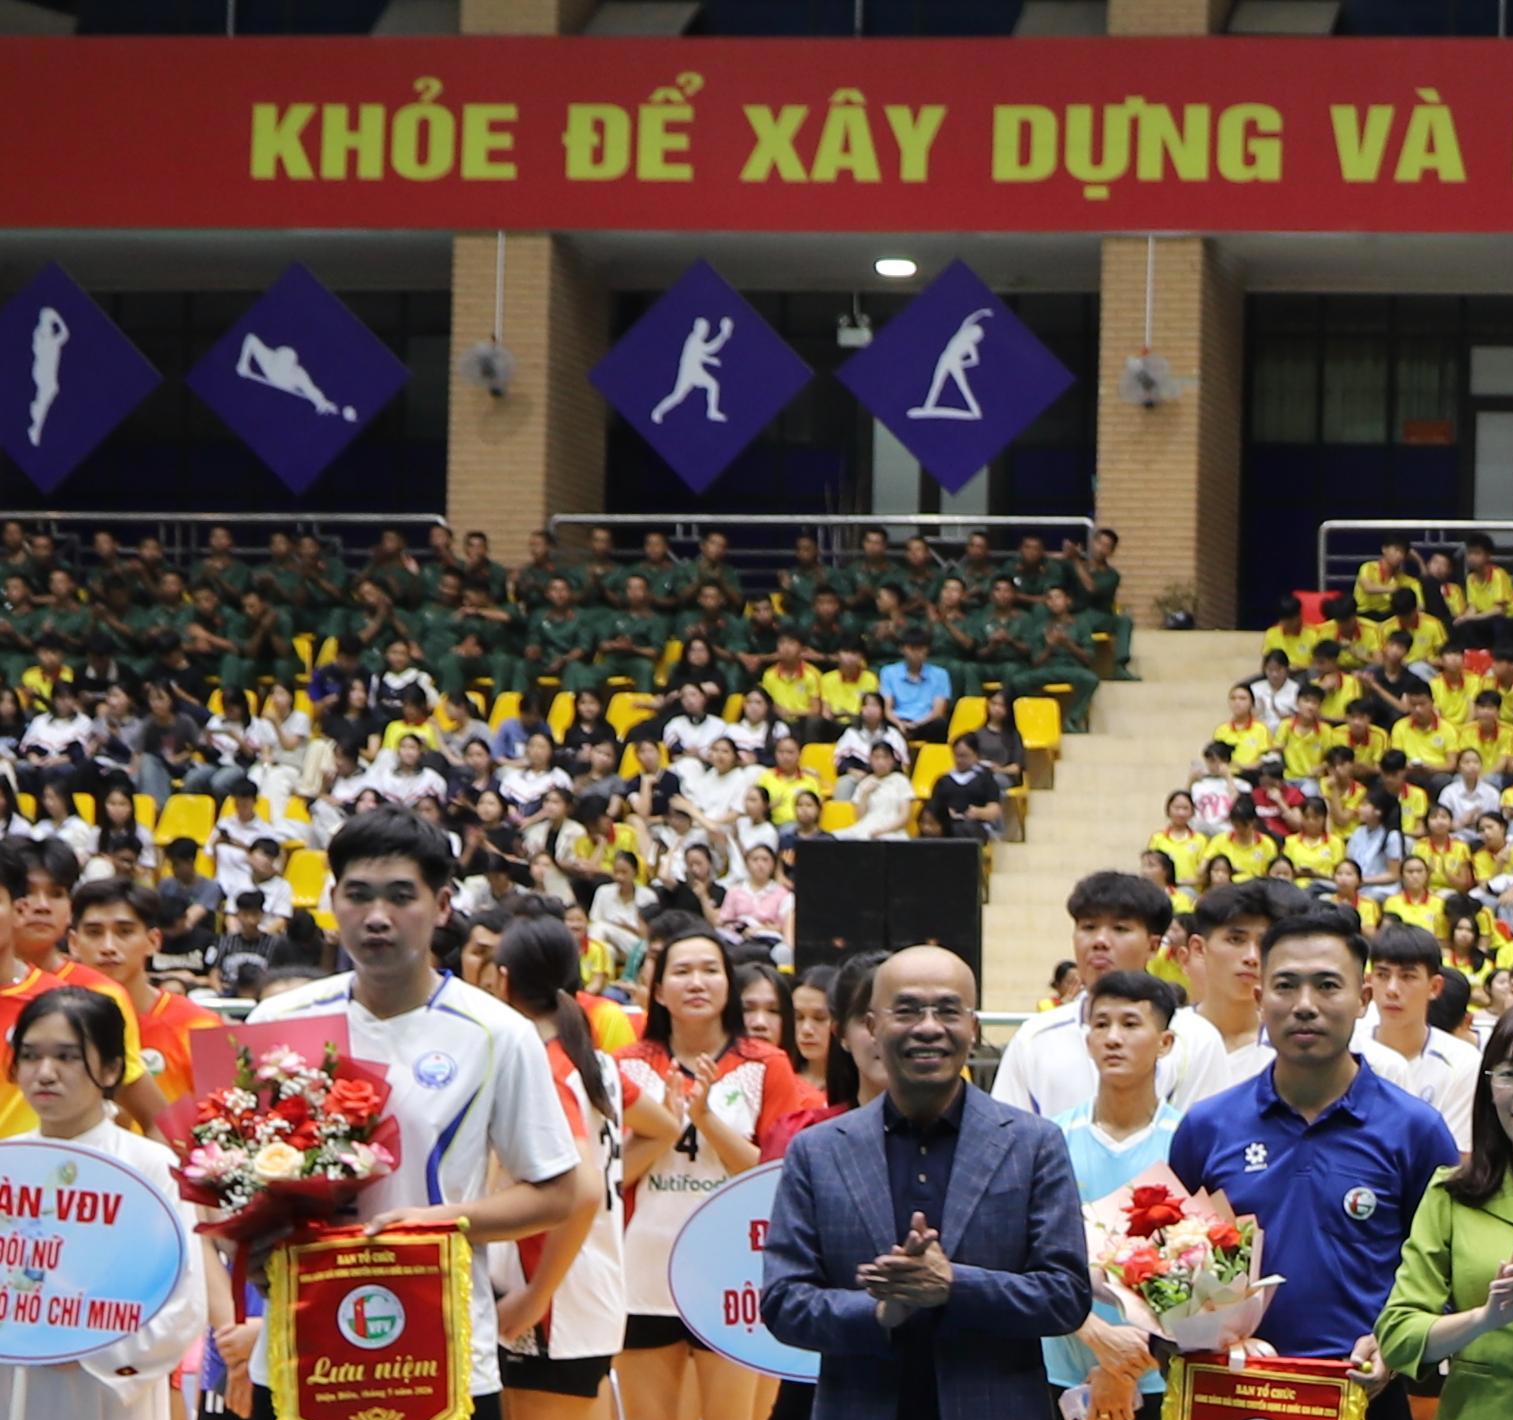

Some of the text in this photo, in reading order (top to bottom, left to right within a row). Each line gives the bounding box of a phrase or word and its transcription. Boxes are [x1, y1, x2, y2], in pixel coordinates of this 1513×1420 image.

[251, 76, 518, 181] KHỎE
[563, 71, 704, 181] ĐỂ
[739, 88, 947, 183] XÂY
[992, 96, 1282, 199] DỰNG
[1330, 89, 1467, 183] VÀ
[675, 1122, 698, 1162] 4
[0, 1176, 123, 1225] ÀN VĐV
[32, 1234, 64, 1270] NỮ
[47, 1291, 83, 1328] CHÍ
[86, 1299, 141, 1333] MINH
[723, 1280, 768, 1334] ĐỘ
[306, 1355, 438, 1385] Lưu niệm
